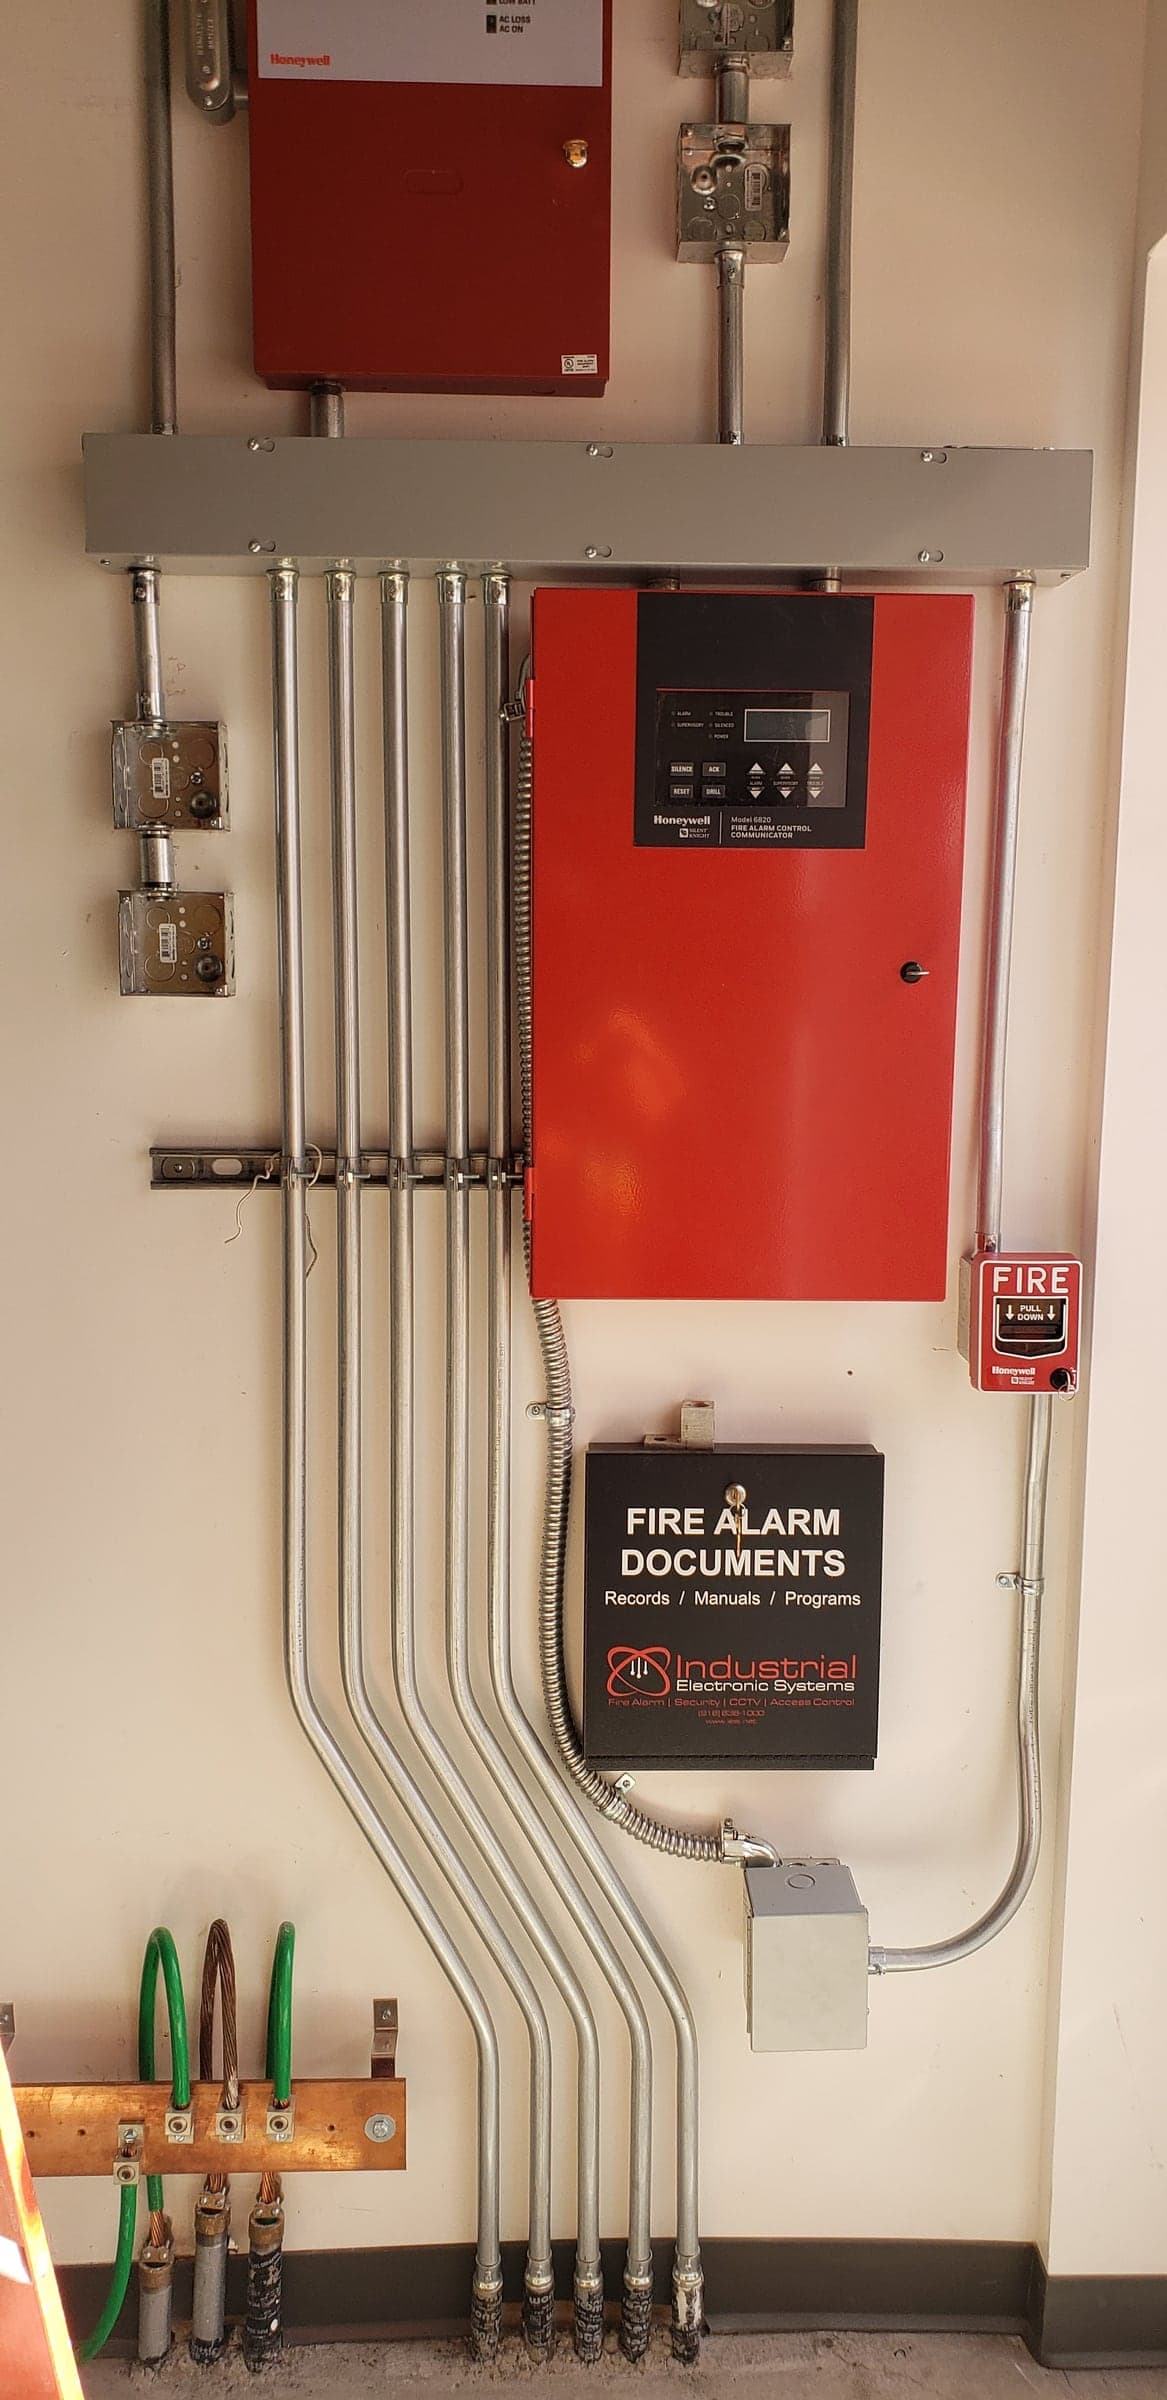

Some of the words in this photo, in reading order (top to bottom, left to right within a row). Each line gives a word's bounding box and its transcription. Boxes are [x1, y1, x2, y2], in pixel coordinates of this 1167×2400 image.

[499, 15, 510, 24] AC
[511, 15, 531, 24] LOSS
[499, 25, 510, 33] AC
[511, 25, 524, 33] ON
[270, 53, 330, 68] Honeywell
[671, 765, 693, 773] SILENCE
[653, 815, 711, 827] Honeywell
[992, 1266, 1070, 1294] FIRE
[1020, 1304, 1042, 1312] PULL
[1017, 1313, 1044, 1321] DOWN
[991, 1365, 1036, 1376] Honeywell
[626, 1507, 705, 1536] FIRE
[713, 1507, 841, 1536] ALARM
[620, 1548, 846, 1578] DOCUMENTS
[604, 1590, 670, 1606] Records
[694, 1590, 761, 1606] Manuals
[784, 1590, 861, 1609] Programs
[675, 1654, 857, 1680] Industrial
[676, 1679, 769, 1692] Electronic
[774, 1679, 855, 1695] Systems
[607, 1698, 630, 1707] Fire
[631, 1698, 665, 1707] Alarm
[674, 1698, 720, 1708] Security
[729, 1698, 761, 1706] CCTV
[769, 1698, 812, 1707] Access
[812, 1698, 855, 1707] Control
